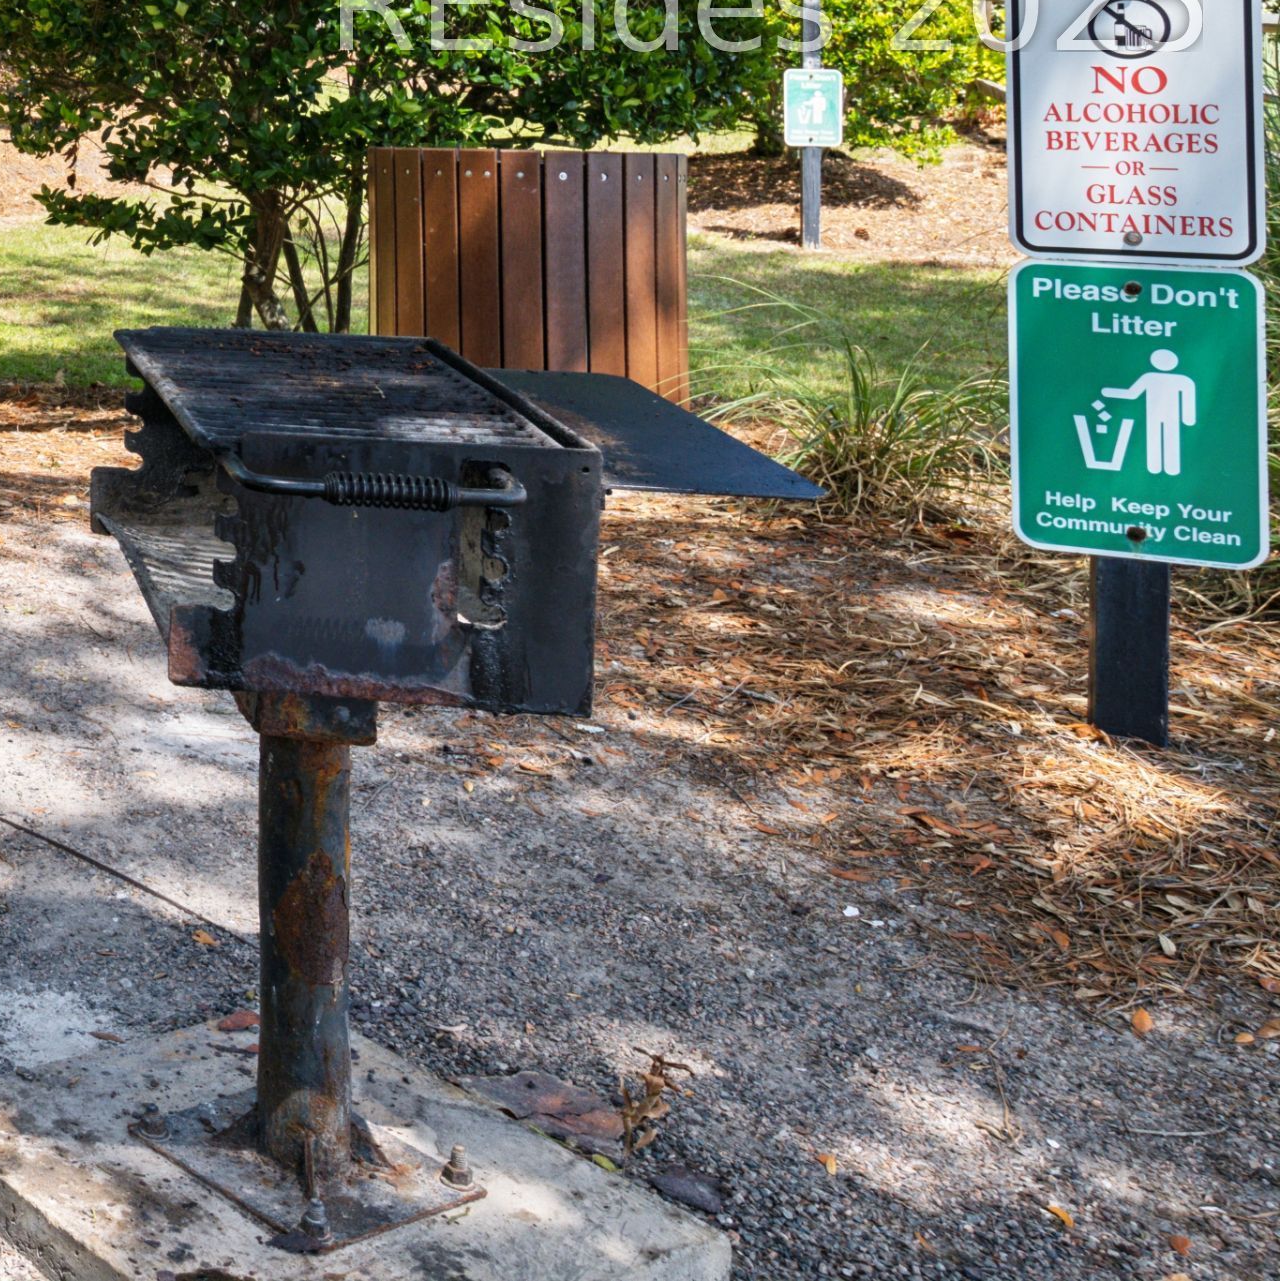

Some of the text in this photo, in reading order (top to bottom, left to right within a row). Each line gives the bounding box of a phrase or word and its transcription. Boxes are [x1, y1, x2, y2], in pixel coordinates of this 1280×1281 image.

[1090, 65, 1168, 95] NO
[1043, 102, 1220, 125] ALCOHOLIC
[1045, 130, 1219, 154] BEVERAGES
[1115, 160, 1146, 176] OR
[1086, 183, 1178, 207] GLASS
[1034, 210, 1233, 238] CONTAINERS
[1150, 283, 1239, 309] Don't
[1091, 312, 1177, 337] Litter
[1045, 490, 1232, 523] Help Keep Your
[1173, 525, 1241, 547] Clean
